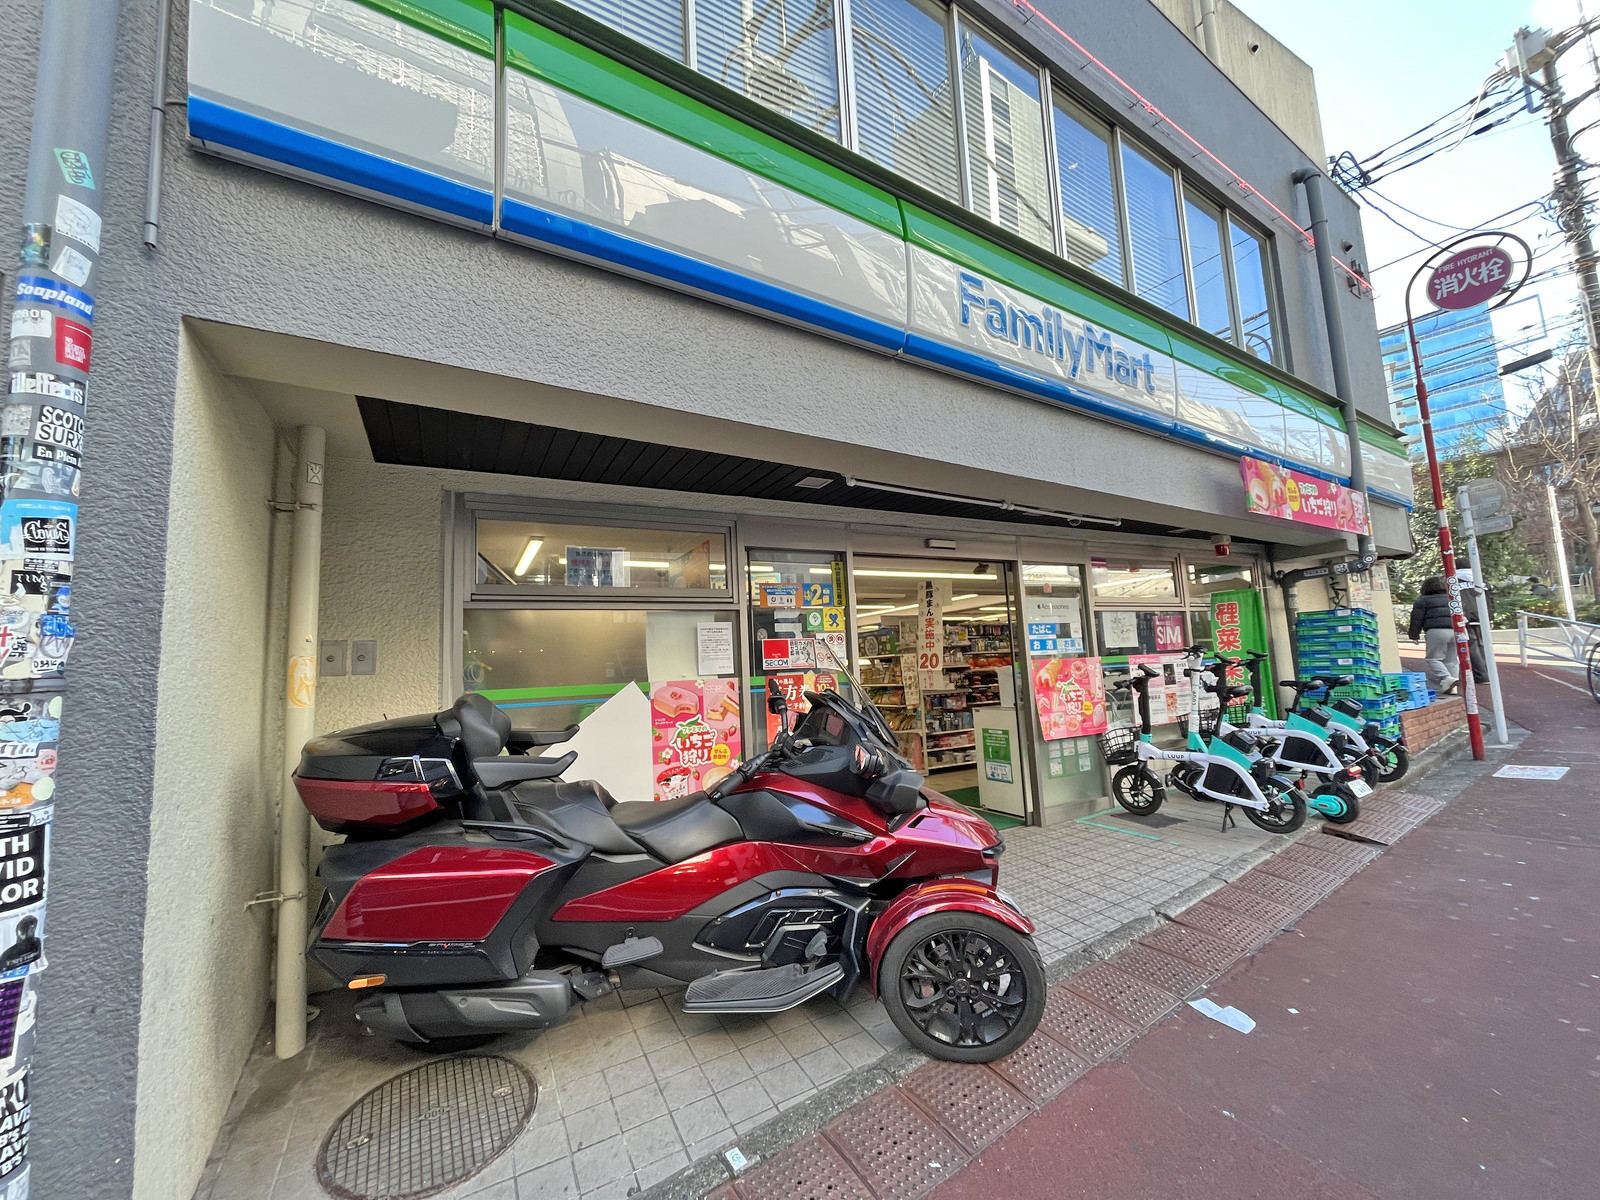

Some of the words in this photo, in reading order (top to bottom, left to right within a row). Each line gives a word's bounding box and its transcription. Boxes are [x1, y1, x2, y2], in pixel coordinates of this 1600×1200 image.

[1438, 262, 1456, 275] FIRE
[1457, 248, 1494, 268] HYDRANT
[1433, 257, 1506, 300] 消火栓
[16, 282, 94, 316] Soapland
[957, 268, 1157, 395] FamilyMart
[1301, 496, 1338, 518] いちご狩り
[1031, 624, 1052, 634] たばこ
[1156, 625, 1182, 645] SIM
[764, 659, 789, 667] SECOM
[919, 652, 940, 670] 20
[676, 731, 715, 749] いちご
[682, 748, 709, 764] 狩り
